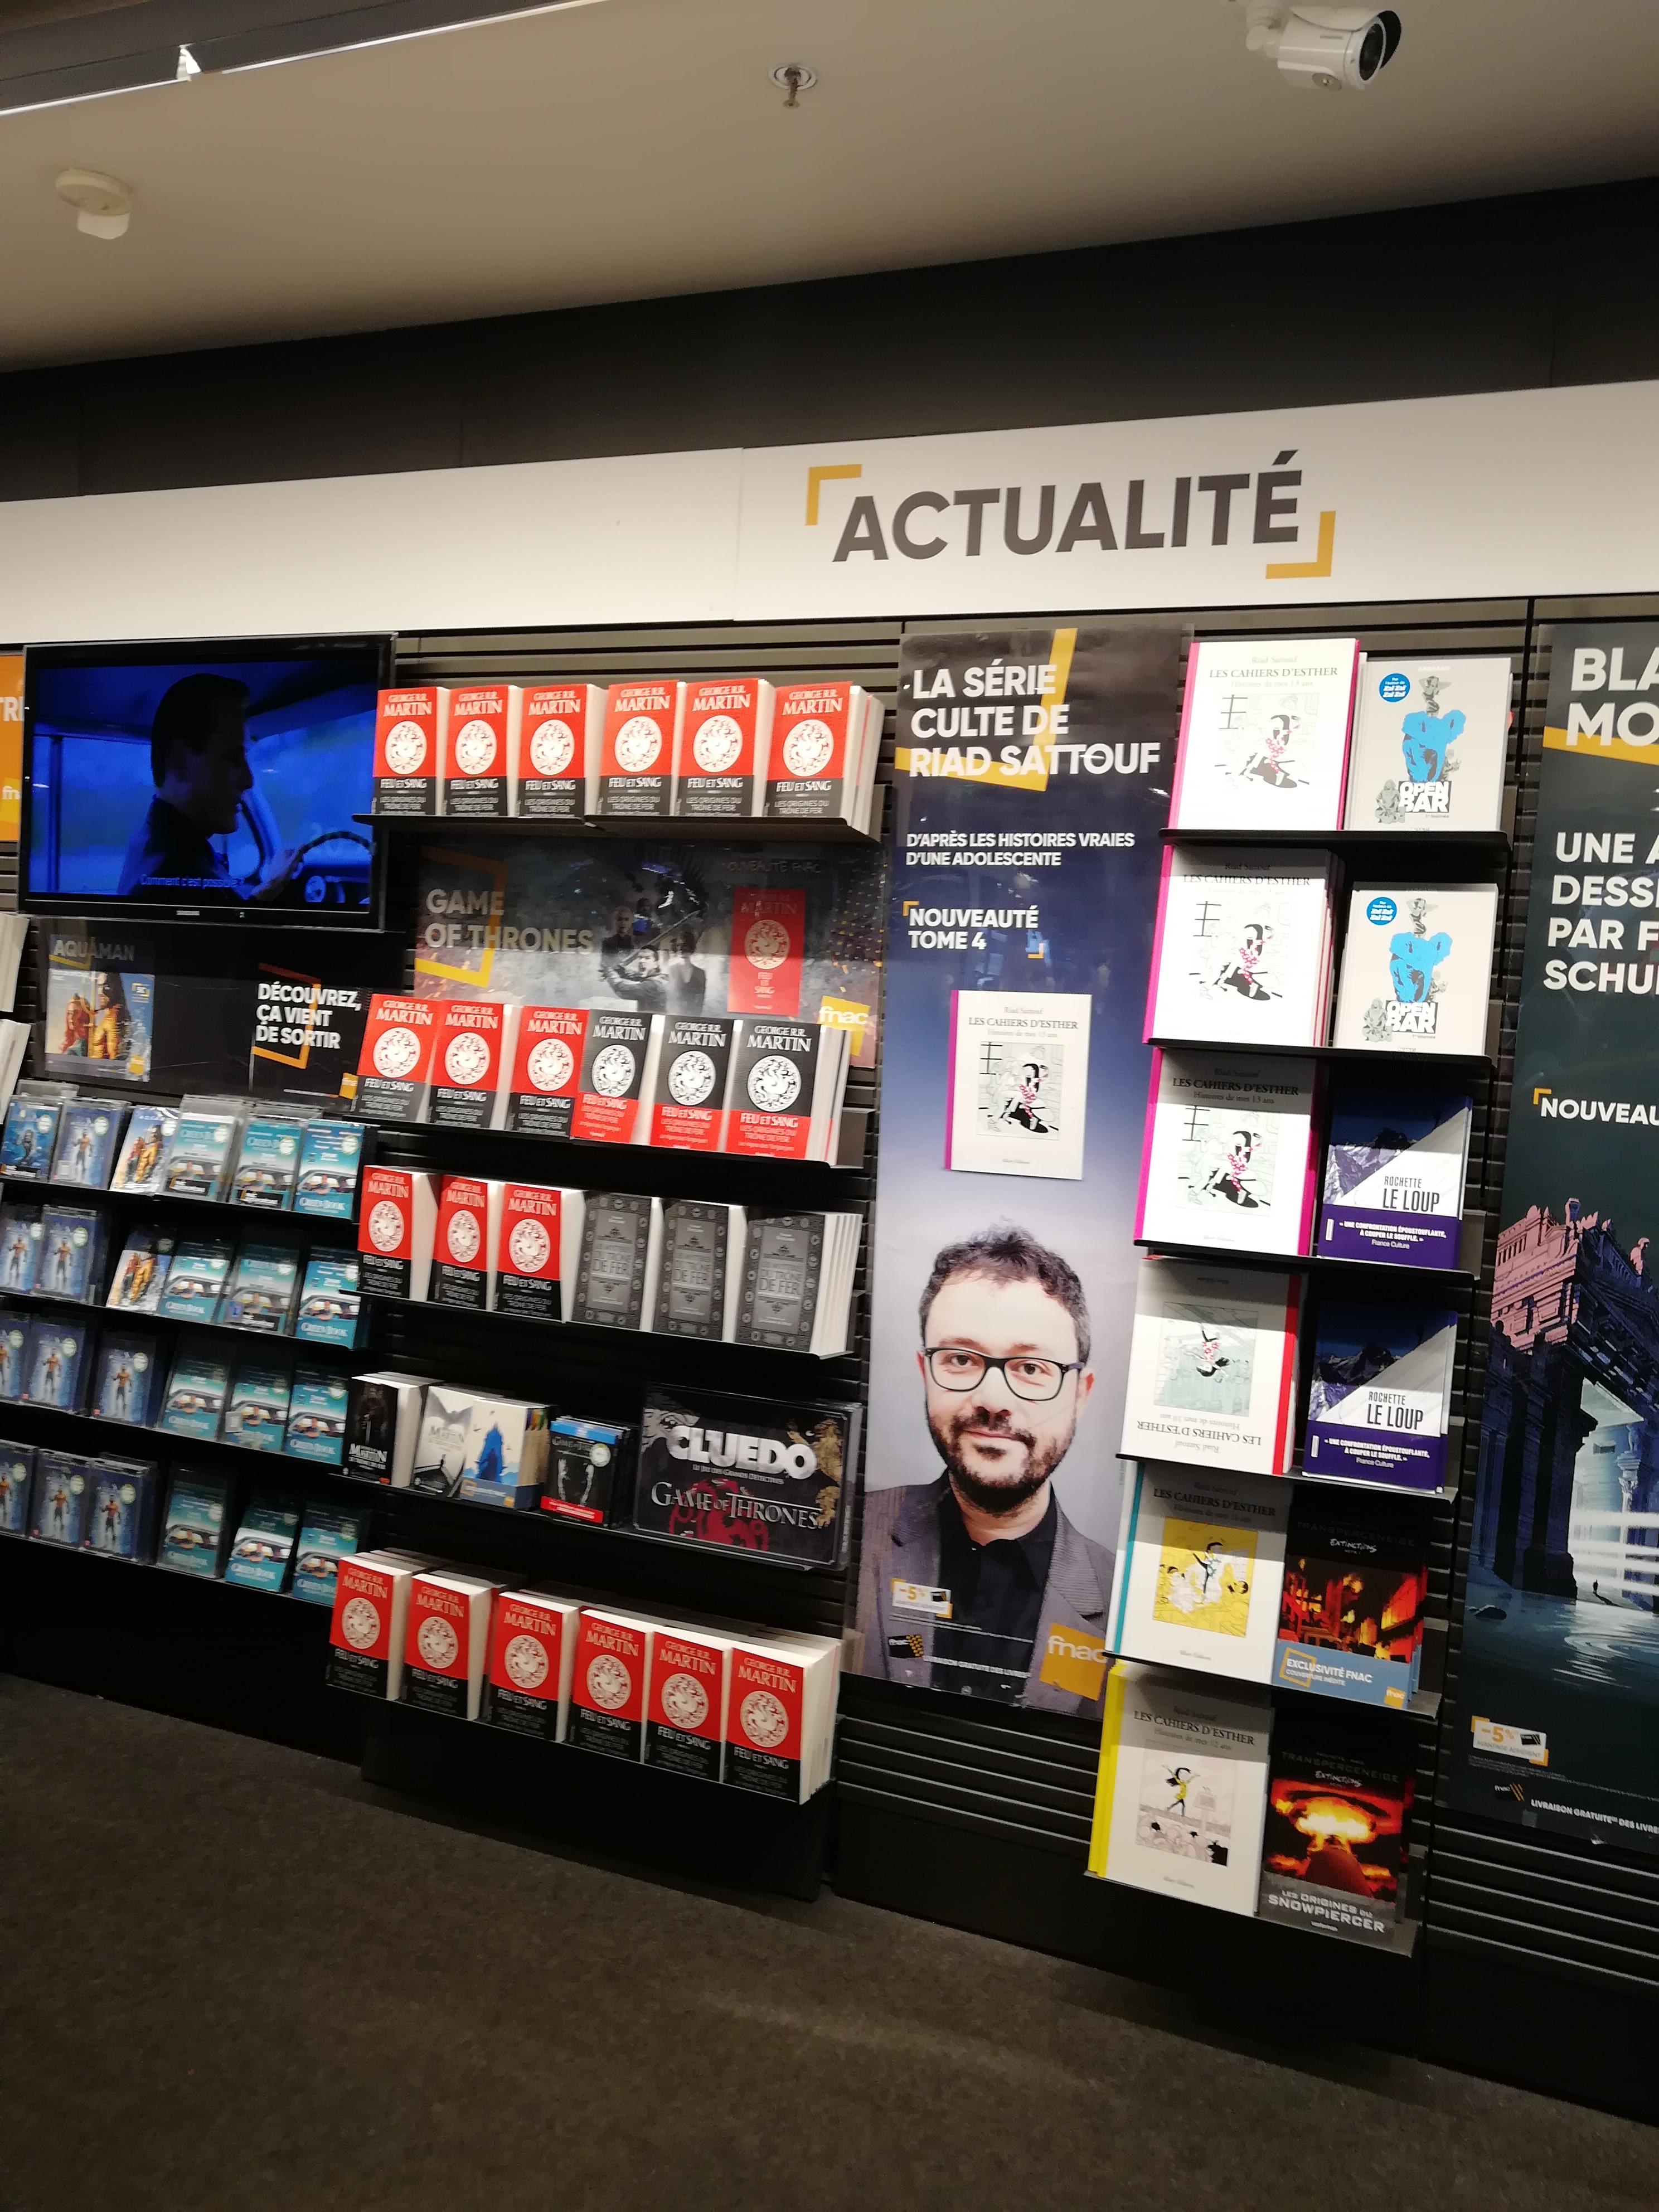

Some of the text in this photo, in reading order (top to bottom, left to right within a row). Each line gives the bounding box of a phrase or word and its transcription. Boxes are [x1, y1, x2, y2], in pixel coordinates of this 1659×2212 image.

[832, 449, 1302, 562] ACTUALITÉ
[913, 658, 1056, 698] LA SÉRIE
[1209, 667, 1338, 678] LES CAHIERS D'ESTHER
[383, 701, 432, 717] MARTIN
[454, 700, 503, 716] MARTIN
[528, 699, 581, 716] MARTIN
[614, 695, 670, 712] MARTIN
[692, 694, 750, 711] MARTIN
[782, 697, 842, 716] MARTIN
[911, 704, 1070, 738] CULTE DE
[909, 742, 1161, 777] RIAD SATTOUF
[608, 777, 626, 787] FEU
[636, 777, 661, 788] SANG
[687, 778, 705, 788] FEU
[715, 778, 743, 788] SANG
[776, 782, 794, 792] FEU
[804, 781, 831, 792] SANG
[1399, 781, 1449, 796] OPEN
[1398, 792, 1449, 812] BAR
[906, 830, 1135, 847] D'APRÈS LES HISTOIRES VRAIES
[1556, 832, 1636, 865] UNE
[906, 852, 1061, 866] D'UNE ADOLESCENTE
[1183, 875, 1201, 883] LES
[1204, 875, 1251, 884] CAHIERS
[425, 888, 505, 916] GAME
[1551, 875, 1659, 909] DESS
[909, 905, 1039, 929] NOUVEAUTÉ
[425, 923, 594, 955] OF THRONES
[908, 930, 987, 949] TOME 4
[1548, 917, 1624, 950] PAR
[53, 939, 134, 962] AQUAMAN
[1543, 959, 1659, 995] SCHU
[257, 982, 362, 1011] DÉCOUVREZ,
[256, 1004, 333, 1026] ÇA VIENT
[376, 1008, 433, 1026] MARTIN
[819, 1005, 869, 1025] fnac
[1386, 1000, 1436, 1016] OPEN
[445, 1013, 499, 1029] MARTIN
[527, 1019, 583, 1035] MARTIN
[968, 1017, 1079, 1030] LES CAHIERS D'ESTHER
[1385, 1012, 1435, 1034] BAR
[256, 1026, 341, 1049] DE SORTIR
[592, 1024, 646, 1041] MARTIN
[668, 1030, 727, 1047] MARTIN
[746, 1034, 812, 1052] MARTIN
[1172, 1078, 1299, 1095] LES CAHIERS D'ESTHER
[740, 1112, 761, 1124] FEU
[771, 1116, 798, 1128] SANG
[367, 1181, 409, 1199] MARTIN
[1384, 1176, 1422, 1189] ROCHETTE
[446, 1189, 484, 1209] MARTIN
[508, 1200, 557, 1216] MARTIN
[1382, 1188, 1440, 1212] LE LOUP
[1368, 1391, 1406, 1405] ROCHETTE
[1367, 1404, 1424, 1430] LE LOUP
[1137, 1420, 1262, 1445] LES CAHIERS D'ESTHER
[666, 1425, 817, 1479] CLUEDO
[651, 1481, 823, 1530] GAME OF THRONES
[1154, 1488, 1276, 1516] LES CAHIERS D'ESTHER
[341, 1575, 389, 1599] MARTIN
[415, 1593, 464, 1618] MARTIN
[503, 1611, 557, 1637] MARTIN
[585, 1629, 639, 1657] MARTIN
[1048, 1635, 1107, 1663] fnac
[659, 1648, 716, 1675] MARTIN
[1287, 1657, 1374, 1684] EXCLUSIVITÉ FNAC
[738, 1665, 797, 1693] MARTIN
[1133, 1710, 1152, 1721] LES
[1154, 1715, 1200, 1733] CAHIERS
[1531, 1799, 1573, 1815] LIVRAISON
[1299, 1893, 1358, 1914] ORIGINES
